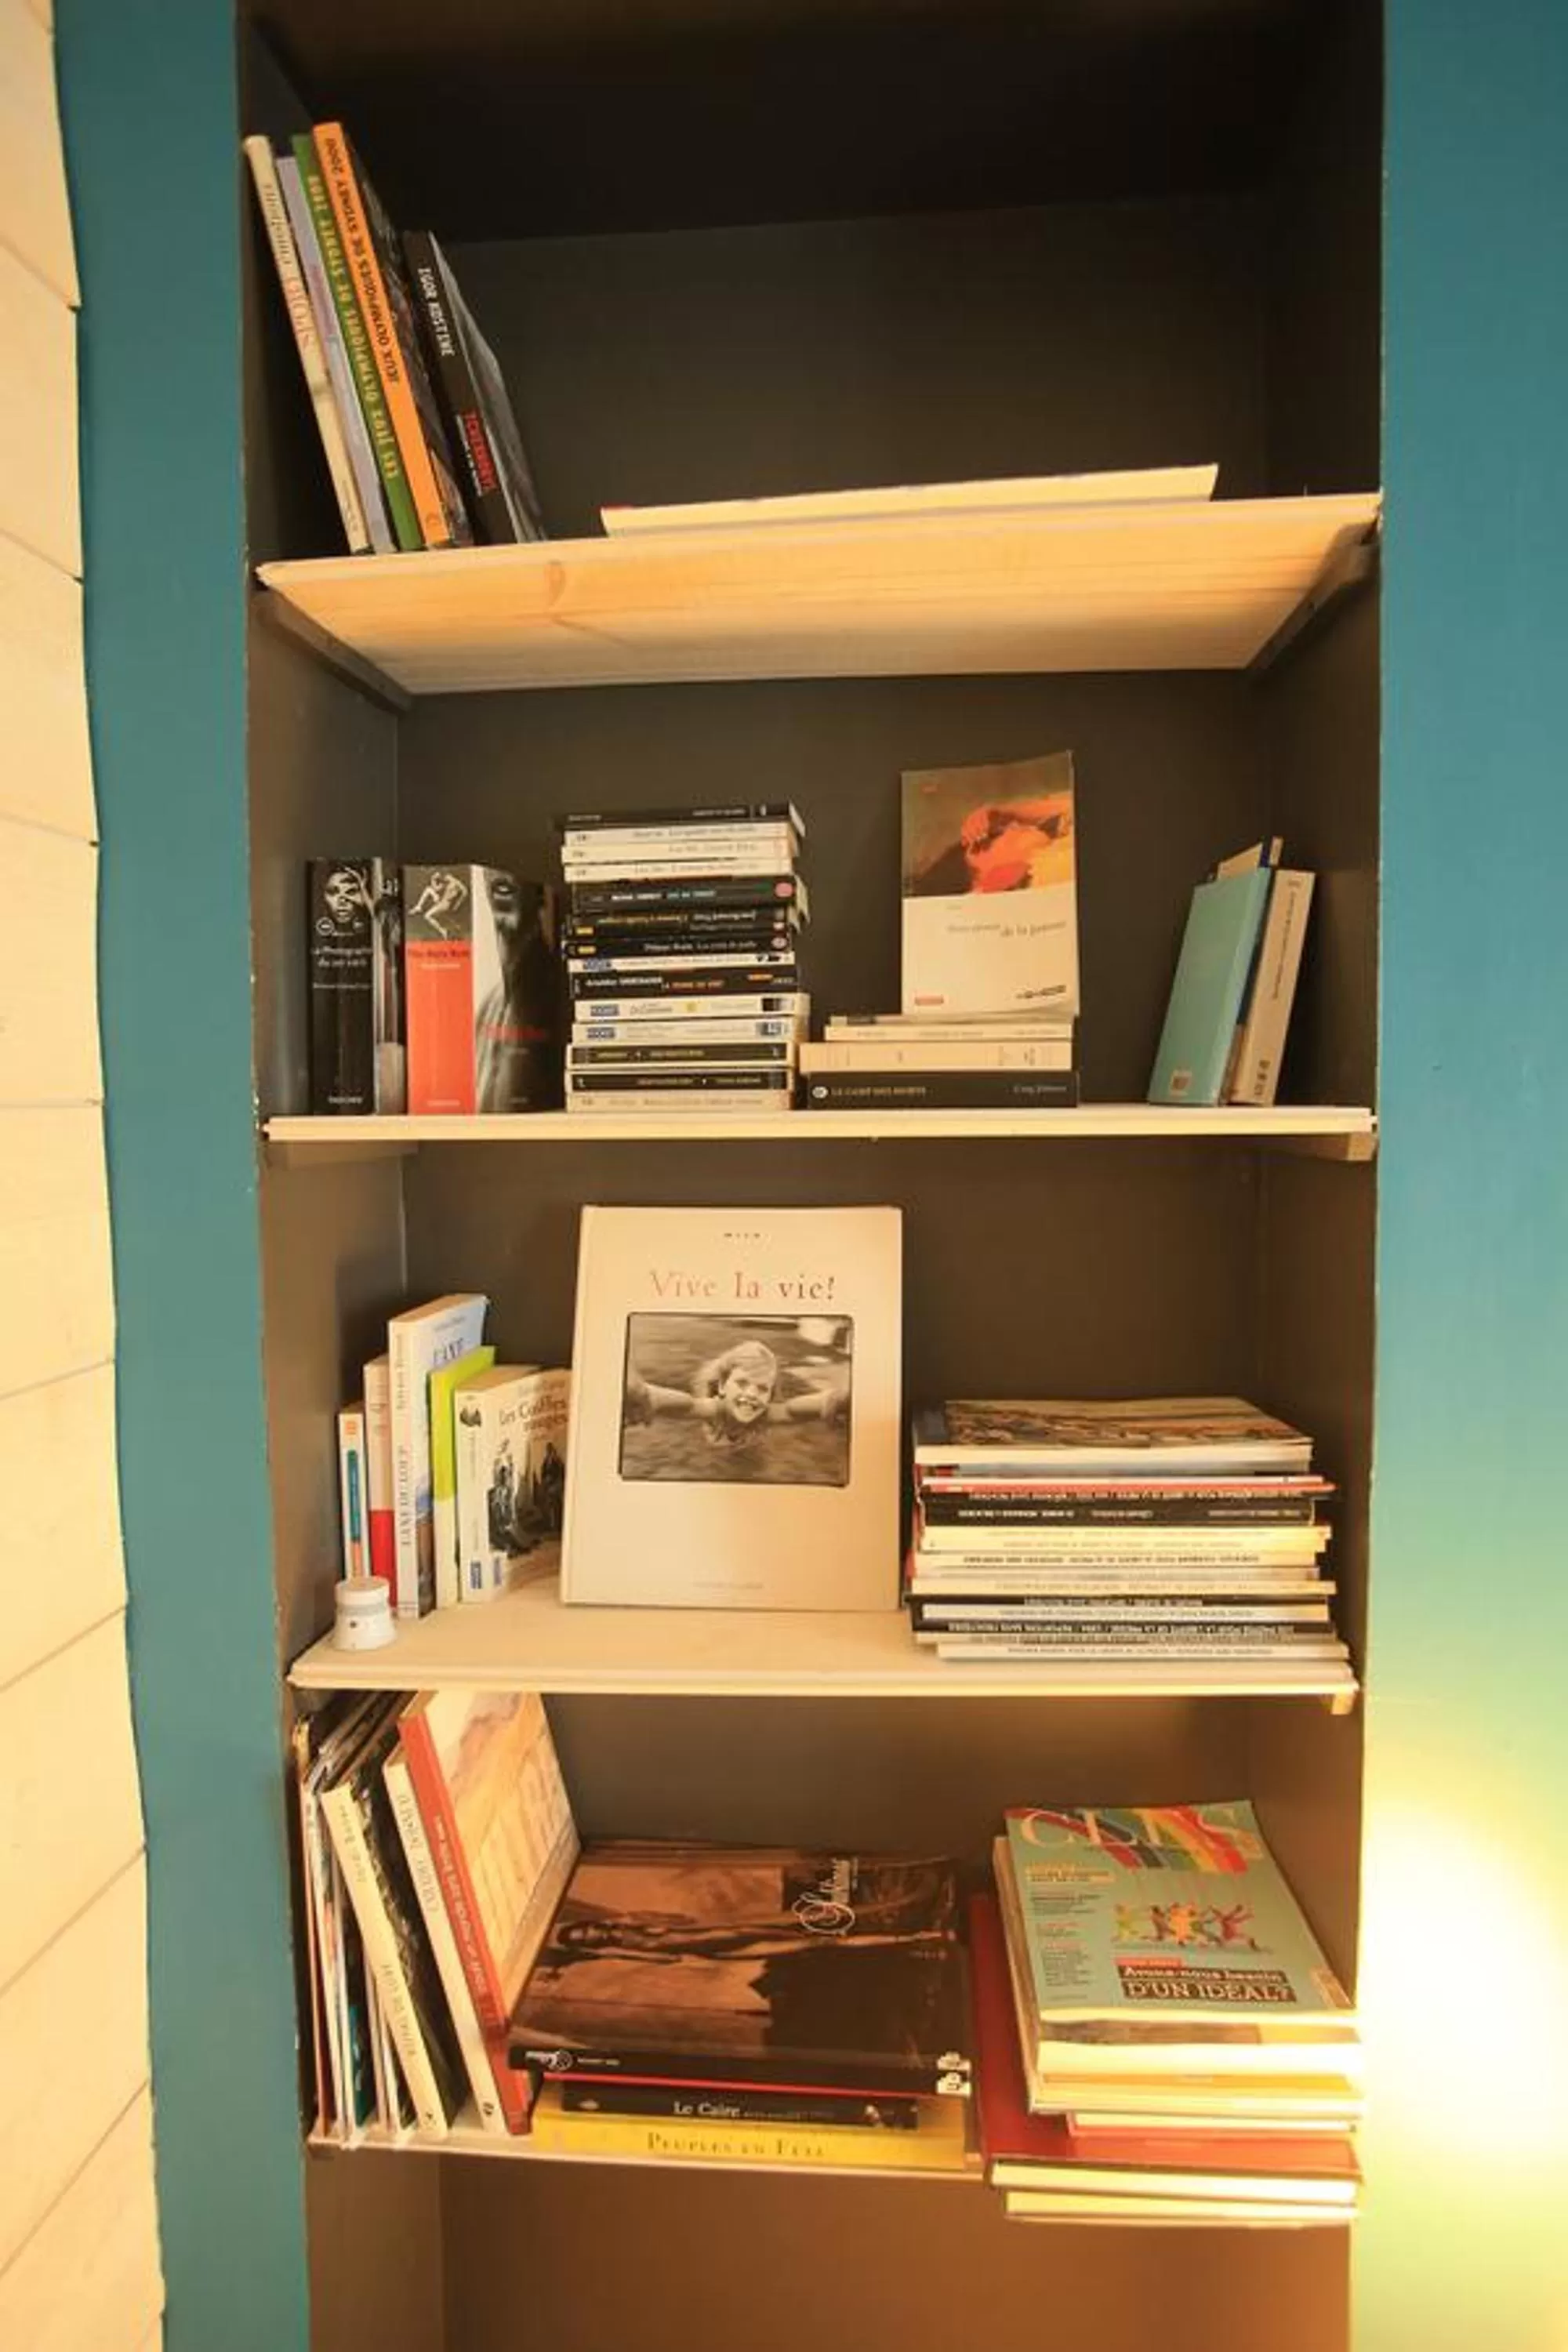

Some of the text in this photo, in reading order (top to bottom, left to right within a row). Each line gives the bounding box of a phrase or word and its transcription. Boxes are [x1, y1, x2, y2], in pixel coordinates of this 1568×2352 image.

[335, 179, 360, 232] SYDNEY
[350, 235, 366, 256] DE
[416, 267, 437, 299] IGOR
[650, 1270, 837, 1301] Vive la vie!
[673, 2100, 740, 2118] Le Caire
